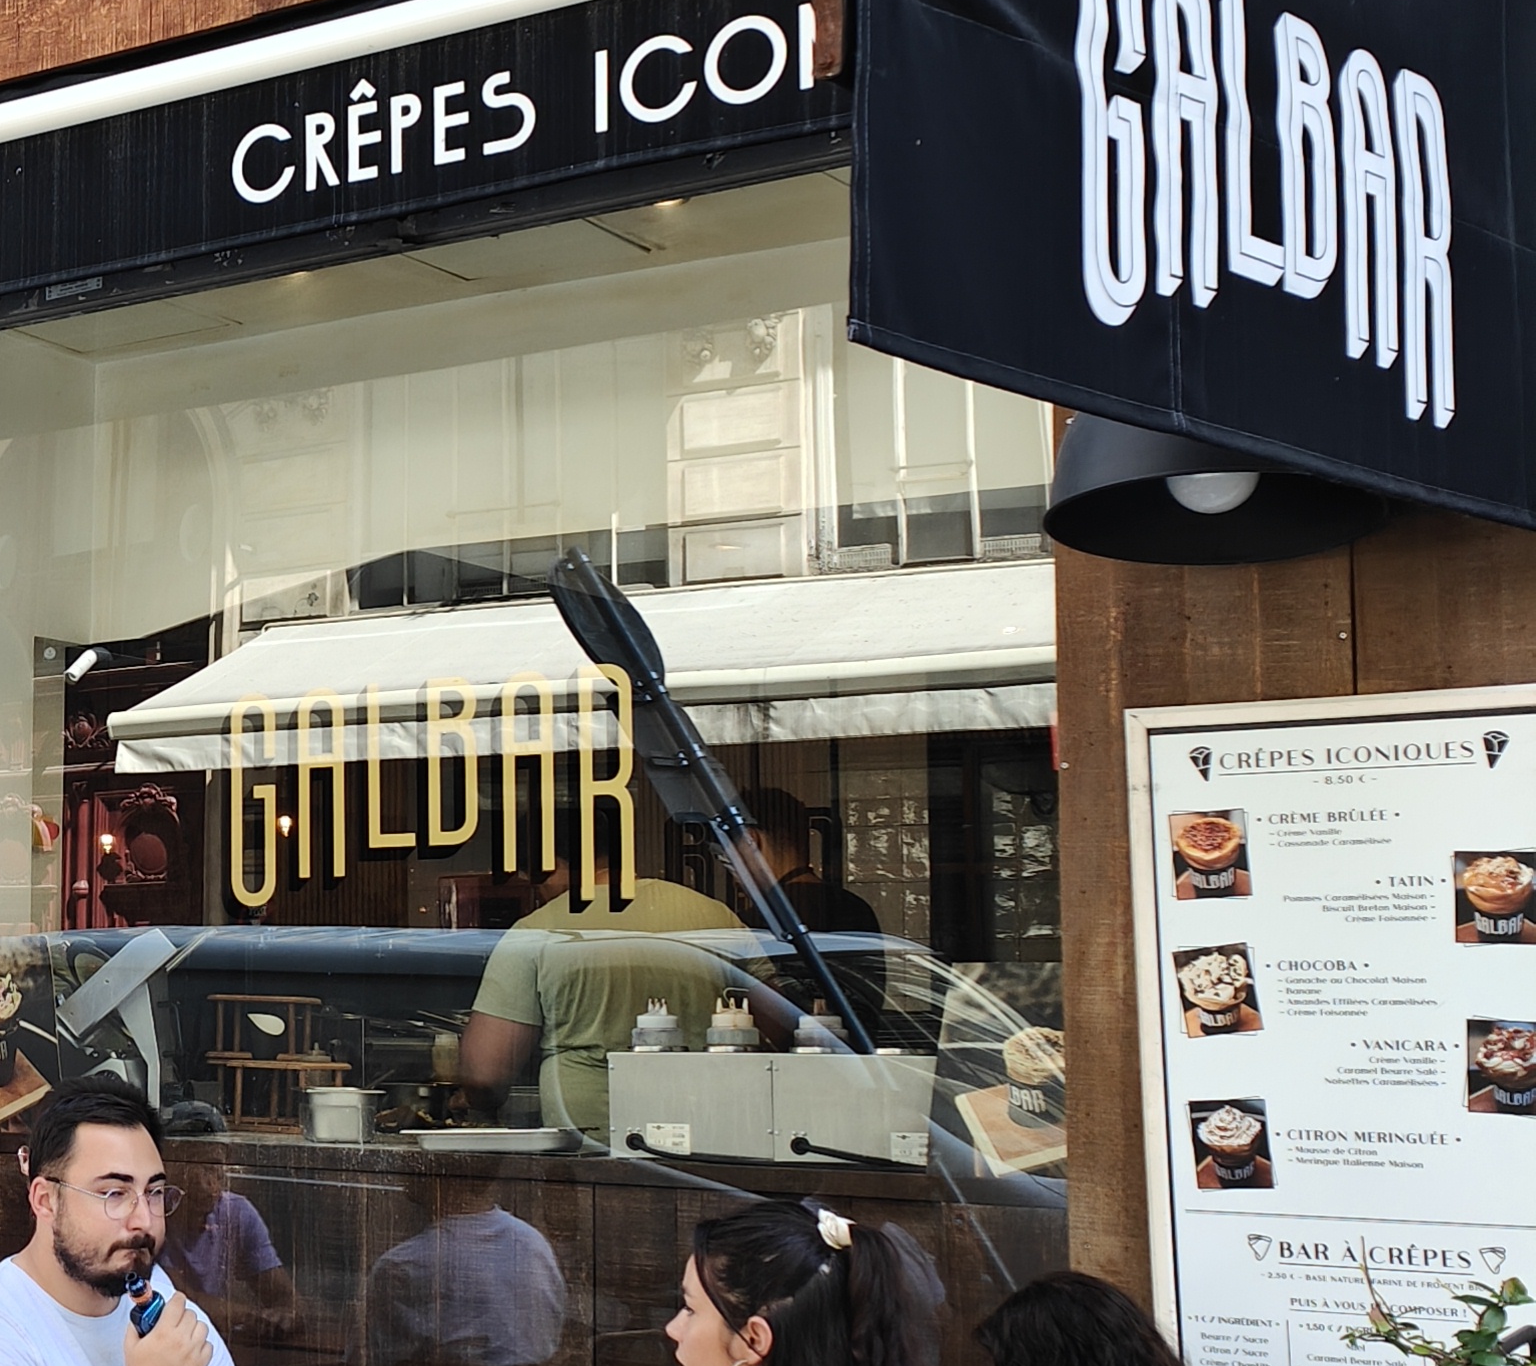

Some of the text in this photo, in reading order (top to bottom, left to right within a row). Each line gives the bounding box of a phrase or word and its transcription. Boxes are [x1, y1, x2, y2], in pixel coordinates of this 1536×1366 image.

[231, 71, 536, 204] CRÊPES
[1219, 740, 1475, 771] CRÊPES ICONIQUES
[1324, 774, 1353, 785] 8.50
[226, 663, 636, 911] GALBAR
[1268, 808, 1388, 825] CRÈME BRÛLÉE
[1389, 876, 1434, 887] TATIN
[1392, 903, 1428, 911] Maison
[1277, 960, 1357, 971] CHOCOBA
[1391, 976, 1427, 984] Maison
[1286, 987, 1322, 995] Banane
[1362, 1039, 1447, 1052] VANICARA
[1287, 1128, 1448, 1145] CITRON MERINGUÉE
[1279, 1240, 1472, 1269] BAR À CRÊPES
[1290, 1297, 1317, 1308] PUIS
[1333, 1300, 1367, 1311] VOUS
